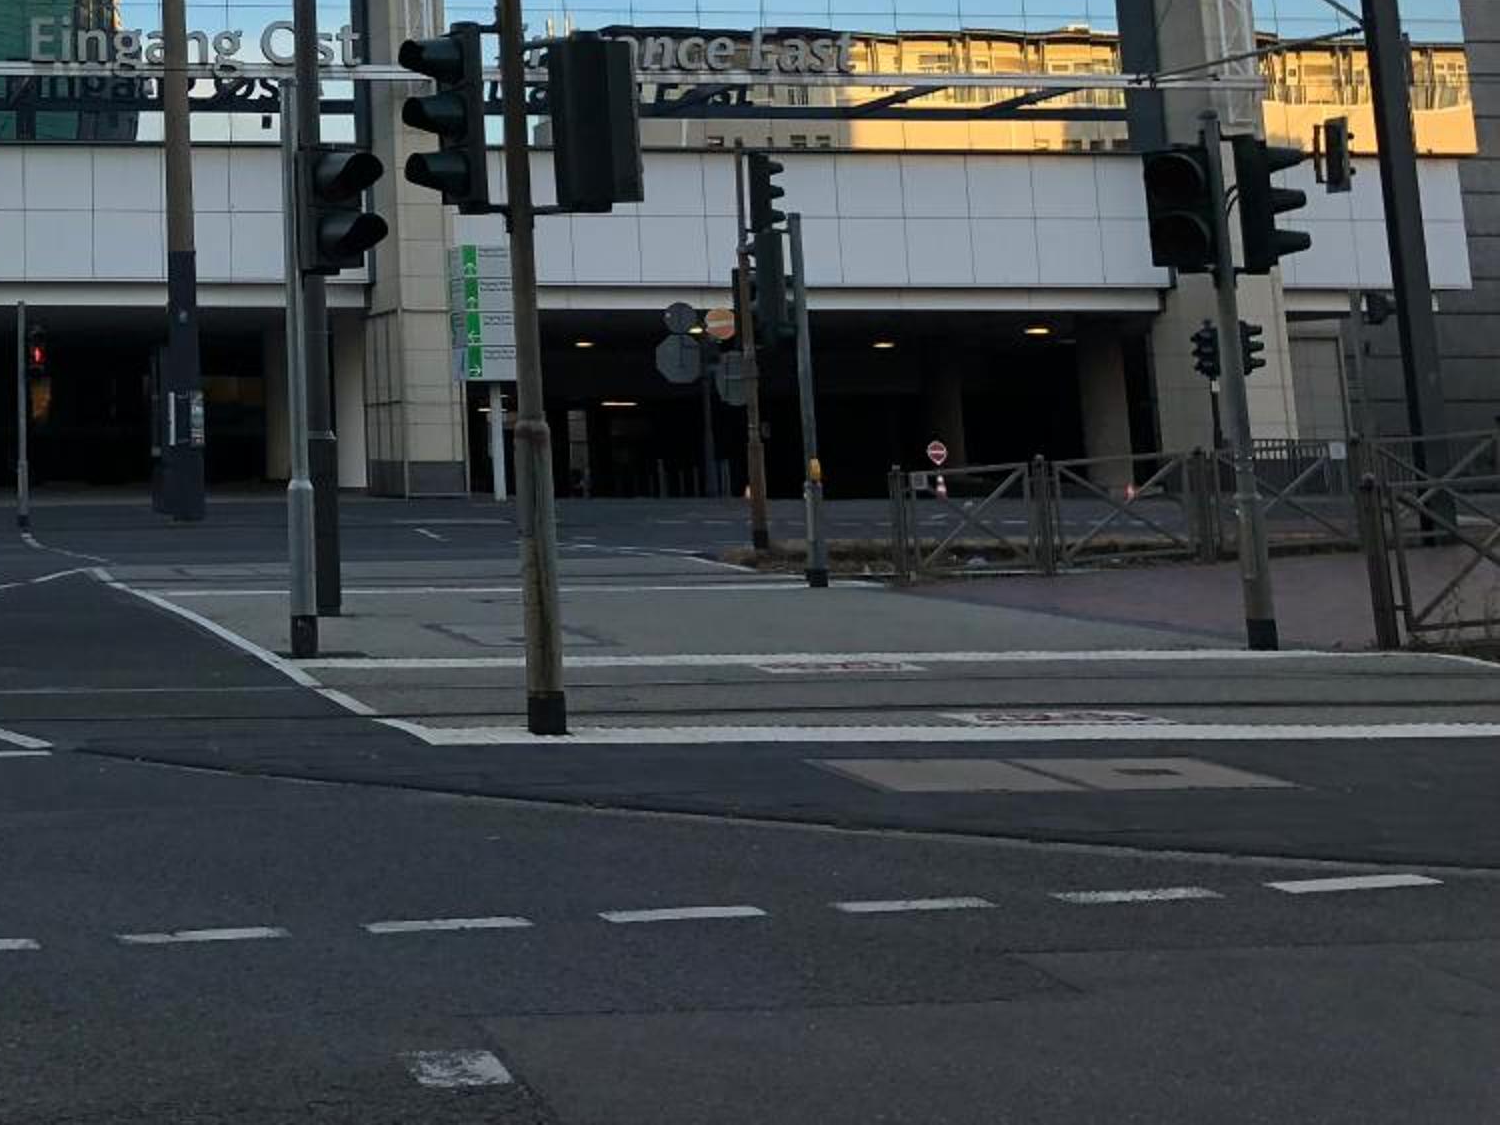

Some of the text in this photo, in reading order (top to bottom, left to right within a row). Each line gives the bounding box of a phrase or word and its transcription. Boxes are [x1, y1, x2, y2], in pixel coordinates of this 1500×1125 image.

[31, 15, 361, 78] Eingang Ost
[748, 26, 856, 73] East
